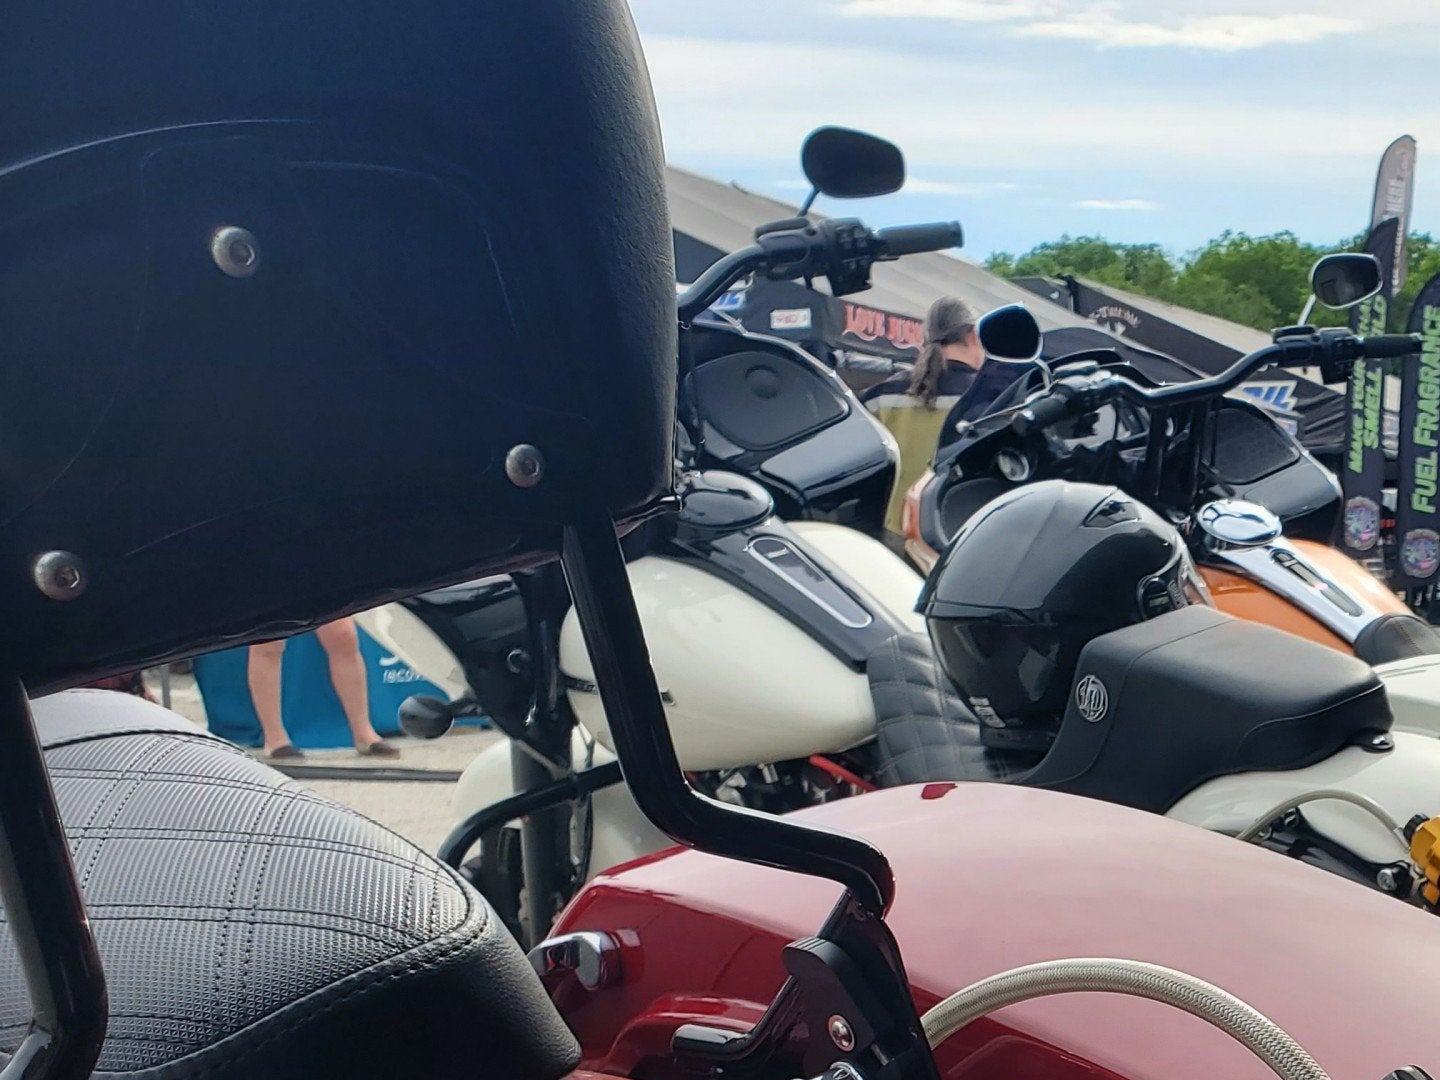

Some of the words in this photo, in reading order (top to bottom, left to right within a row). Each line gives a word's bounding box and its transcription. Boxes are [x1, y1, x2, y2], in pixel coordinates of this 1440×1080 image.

[1363, 366, 1382, 449] SMELL
[1349, 413, 1364, 473] MAKE
[1411, 451, 1440, 514] FUEL
